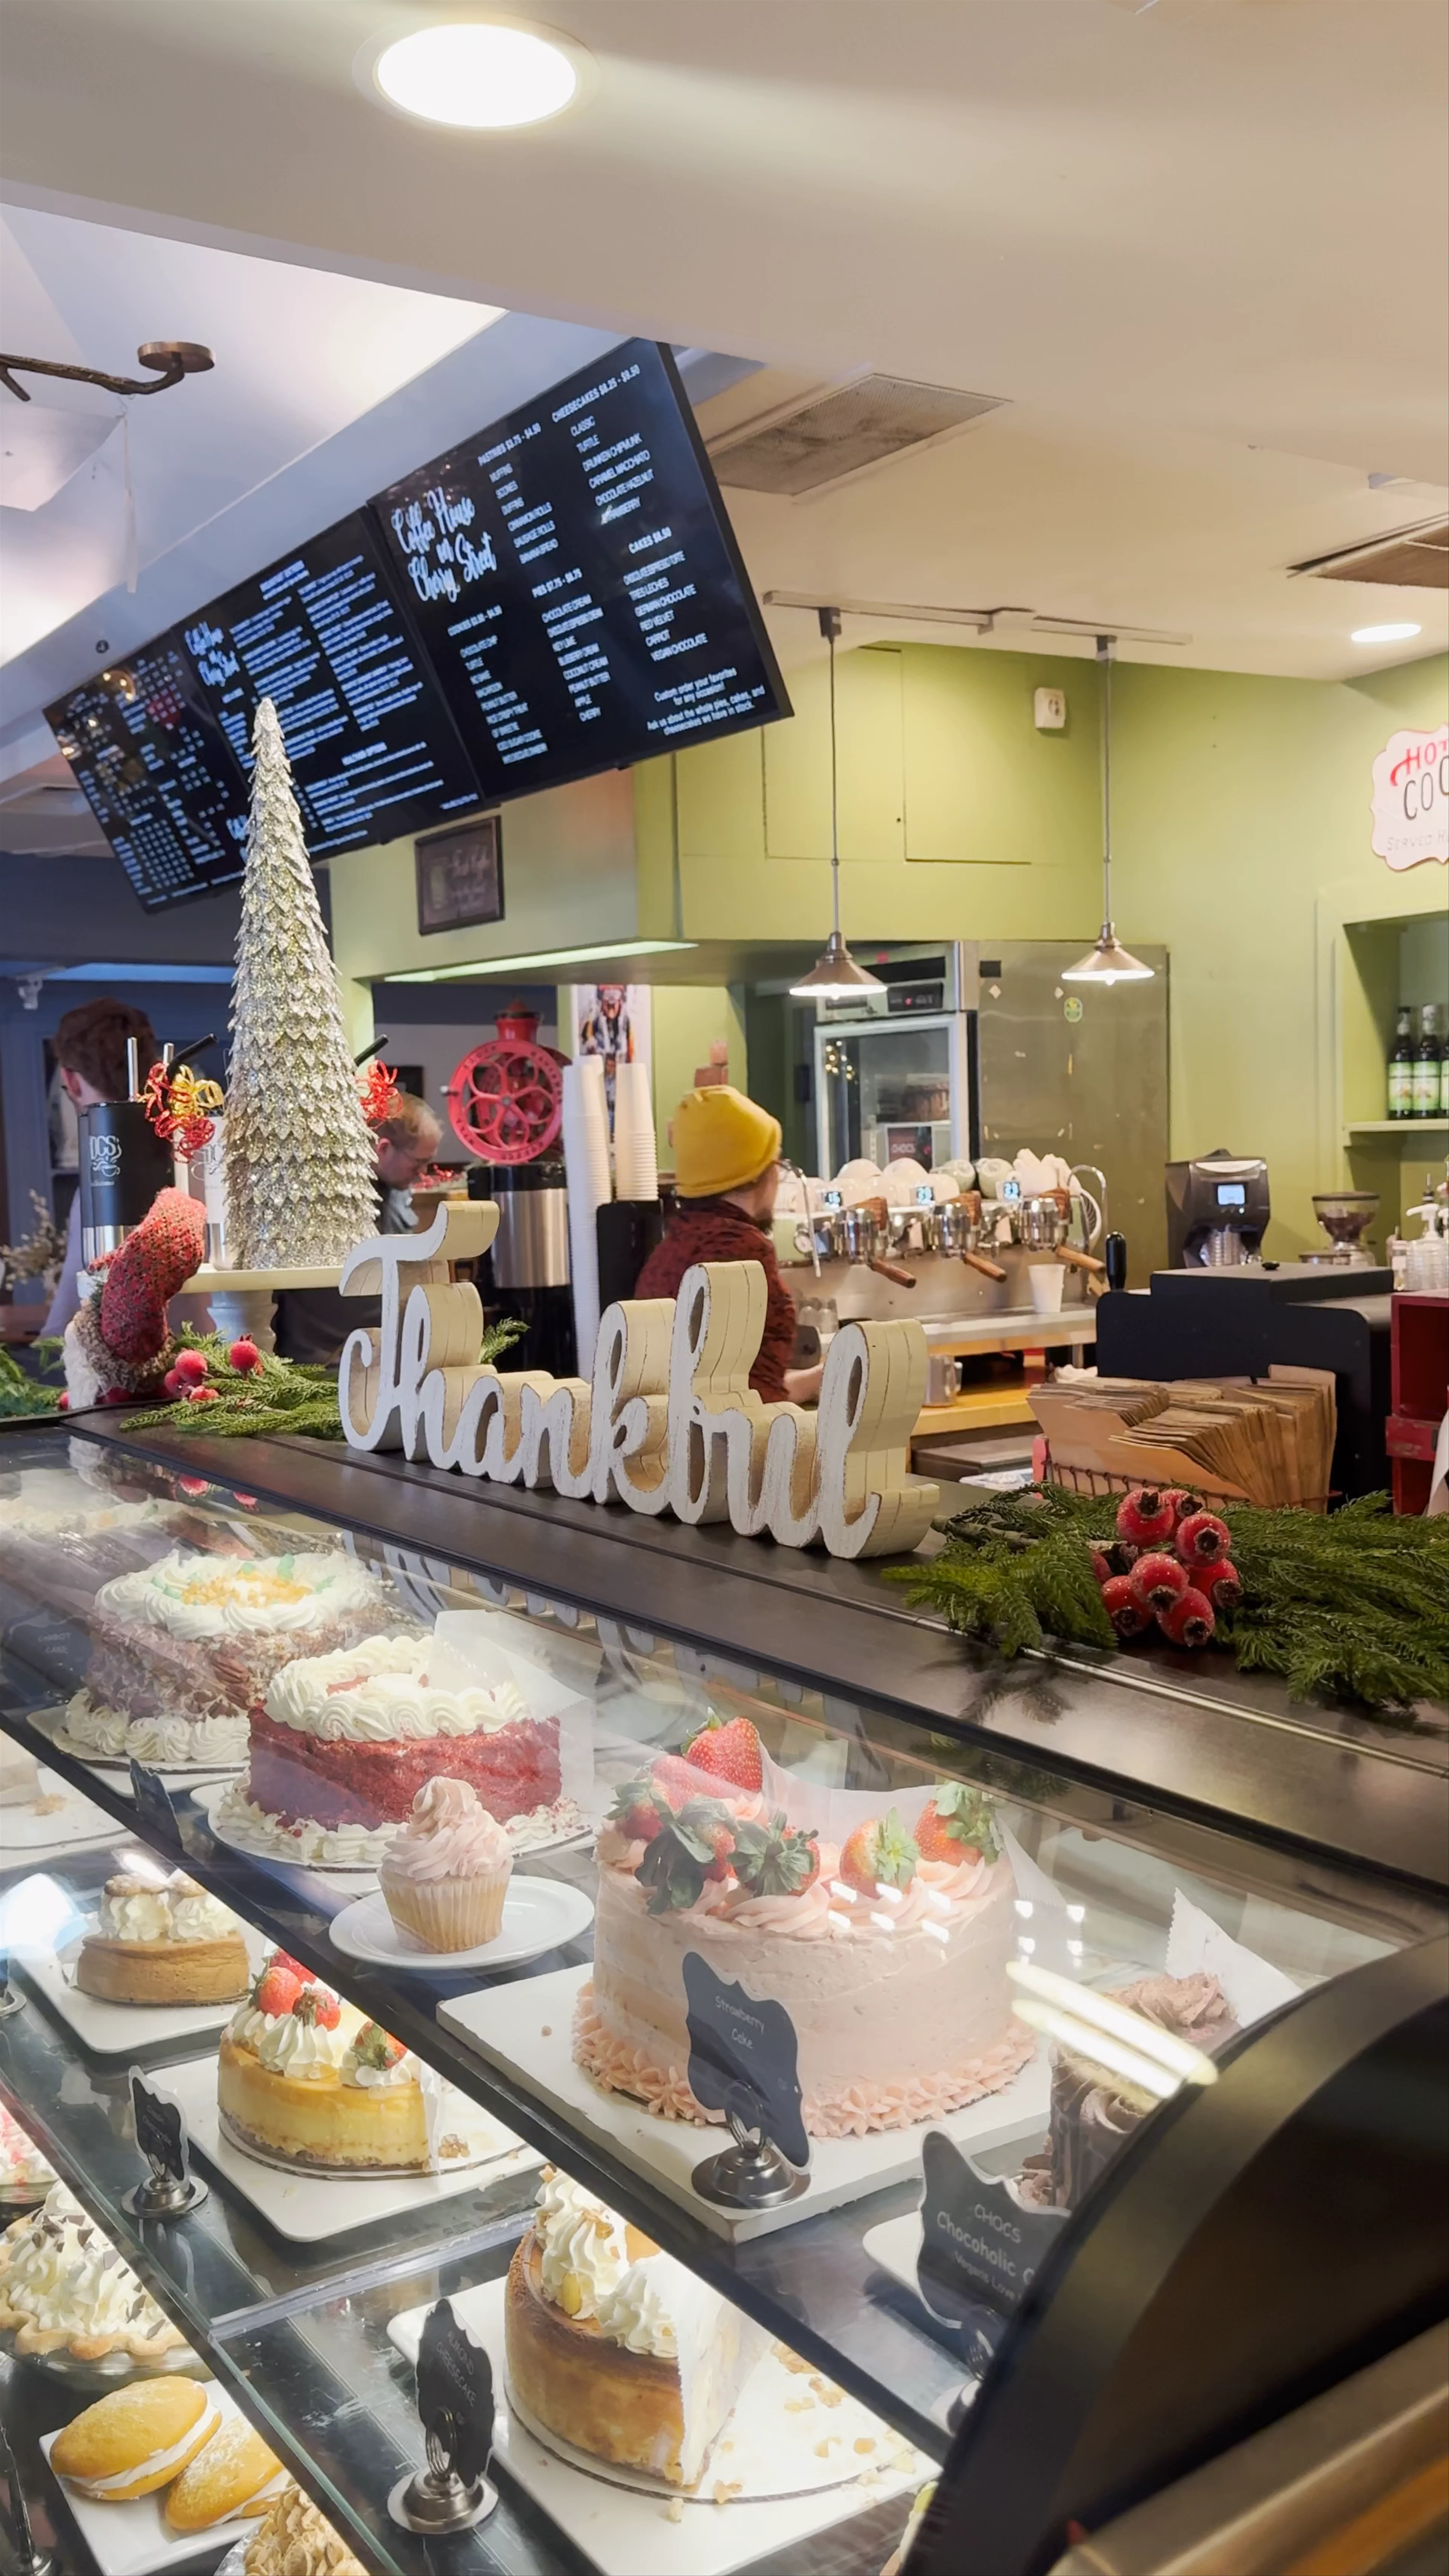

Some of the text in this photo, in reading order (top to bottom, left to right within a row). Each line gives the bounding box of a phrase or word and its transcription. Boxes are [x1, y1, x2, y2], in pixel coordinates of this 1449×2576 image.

[552, 388, 600, 422] CHEESECAKES
[571, 416, 595, 436] CLASSIC
[576, 435, 600, 453] TURTLE
[583, 449, 612, 471] DRUNKEN
[589, 468, 617, 488] CARAMEL
[391, 486, 475, 554] Coffee House
[436, 538, 454, 563] on
[629, 535, 653, 554] CAKES
[408, 556, 461, 603] Cherry
[455, 531, 497, 583] Street
[644, 577, 669, 595] LECHES
[659, 584, 696, 607] CHOCOLATE
[646, 629, 670, 646] CARROT
[671, 633, 708, 654] CHOCOLATE
[339, 1201, 885, 1560] Thankful
[715, 1995, 764, 2034] Strawberry
[732, 2028, 754, 2049] Cake
[974, 2204, 1021, 2244] CHOCS
[937, 2211, 1016, 2277] Chocoholic
[436, 2341, 477, 2408] CHEESECAKE
